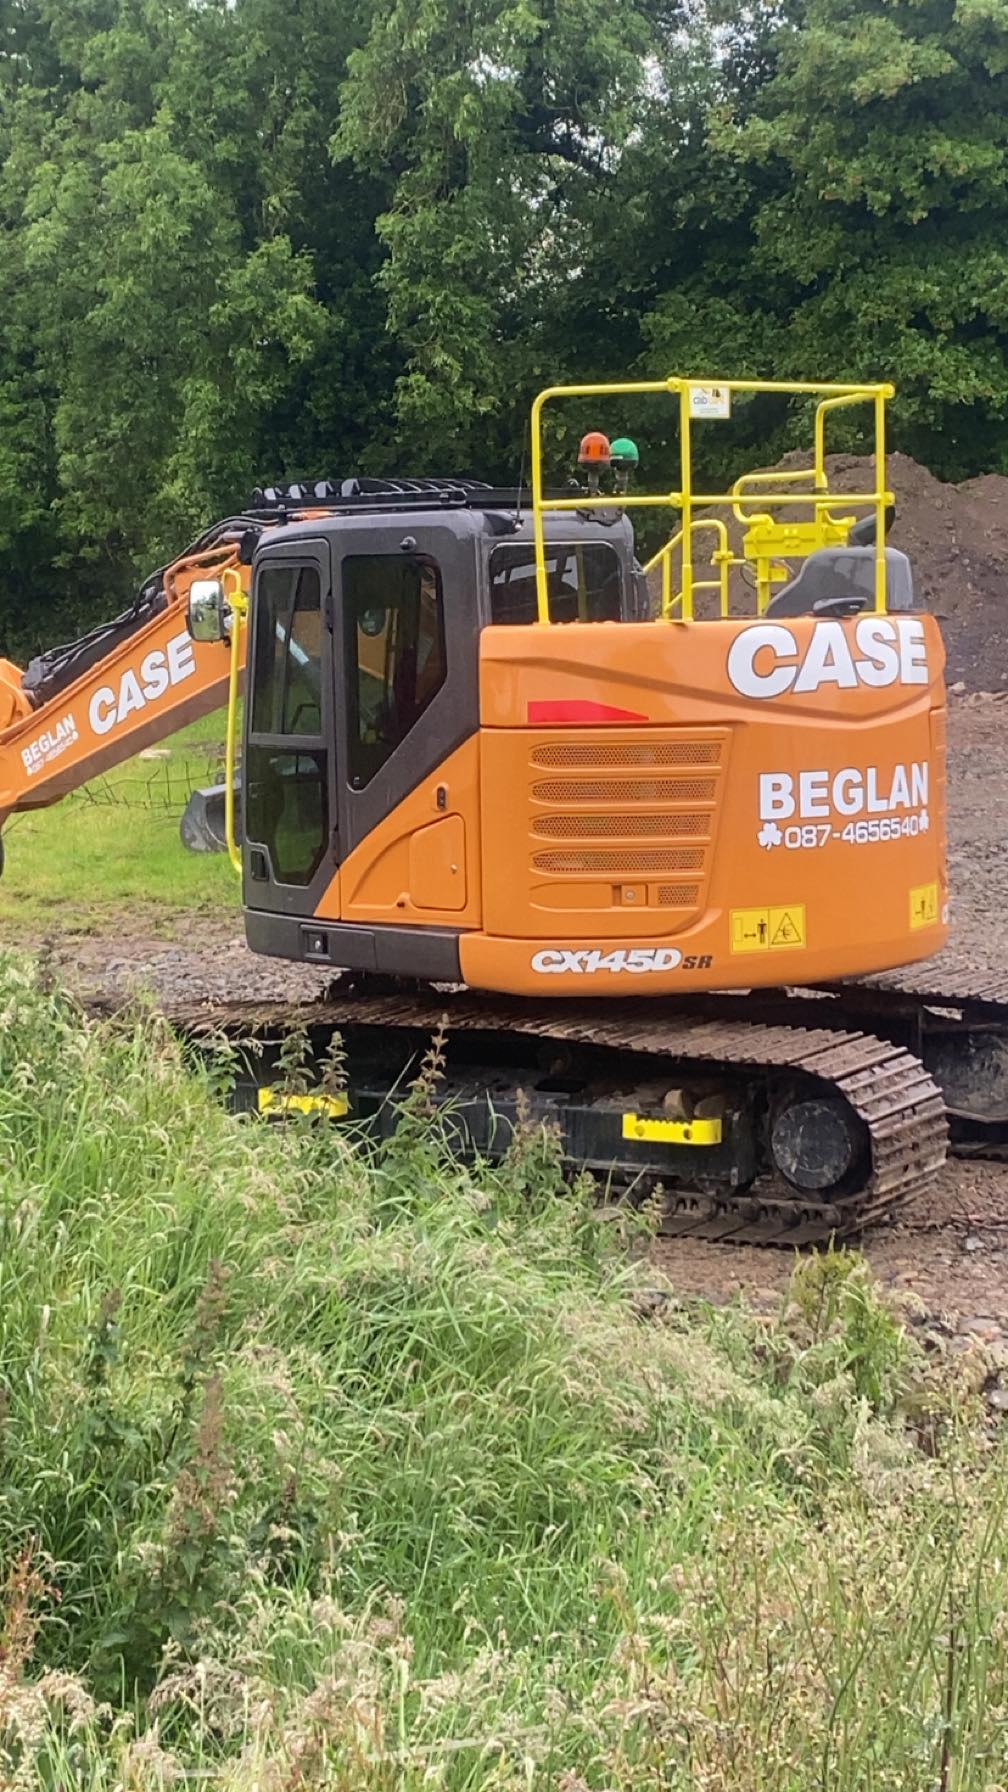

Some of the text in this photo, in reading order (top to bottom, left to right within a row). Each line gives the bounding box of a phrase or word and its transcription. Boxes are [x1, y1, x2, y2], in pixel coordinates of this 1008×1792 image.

[88, 630, 196, 735] CASE
[727, 618, 928, 698] CASE
[21, 713, 76, 768] BEGLAN
[759, 761, 928, 820] BEGLAN
[784, 815, 919, 849] 087-4656540
[531, 948, 713, 973] CX145D SR
